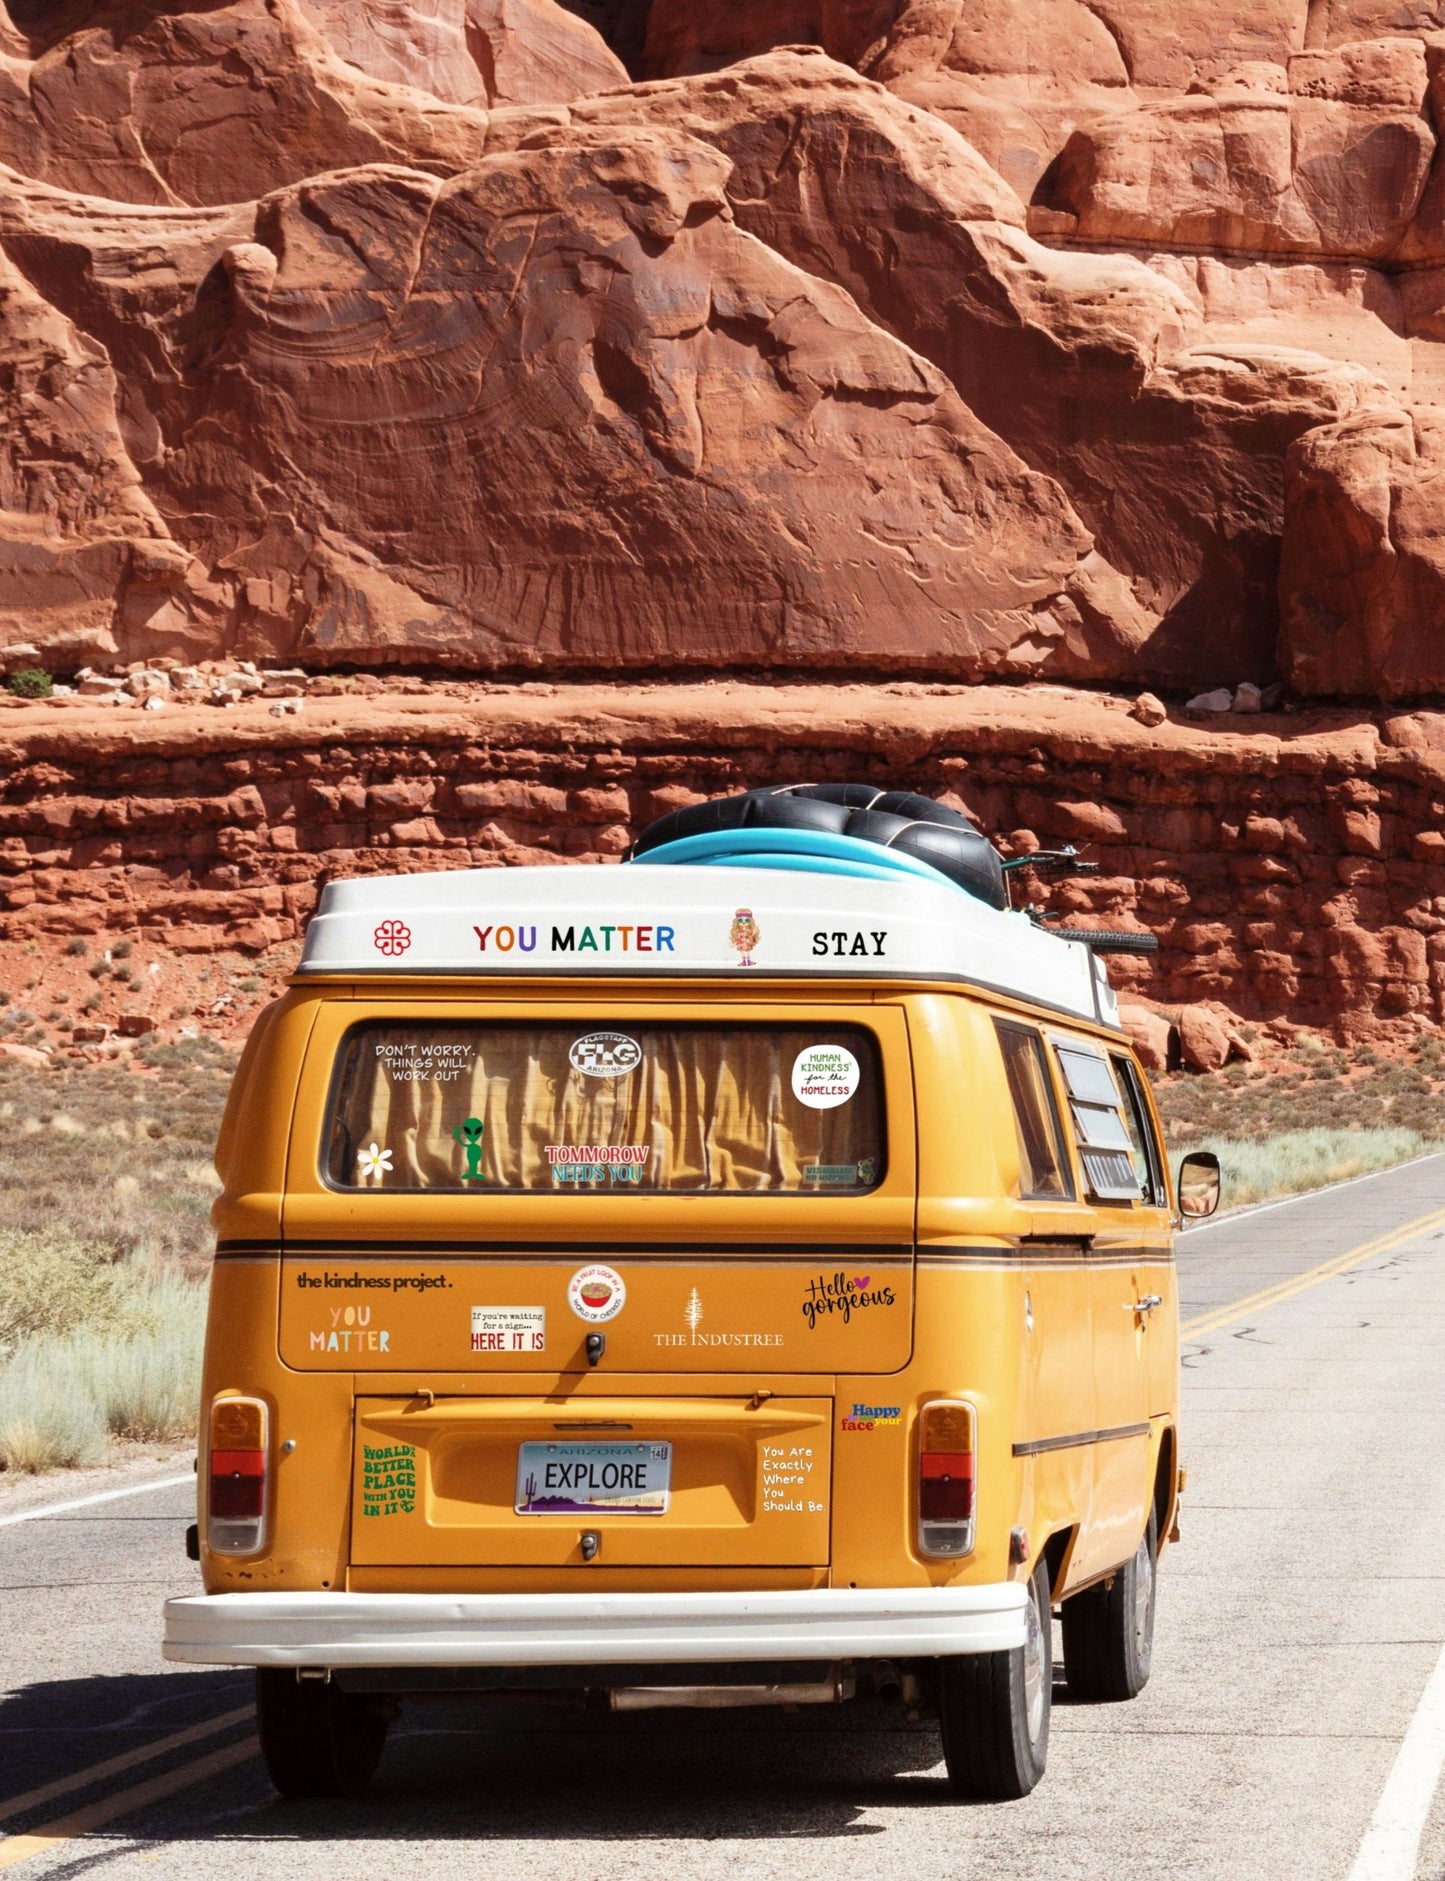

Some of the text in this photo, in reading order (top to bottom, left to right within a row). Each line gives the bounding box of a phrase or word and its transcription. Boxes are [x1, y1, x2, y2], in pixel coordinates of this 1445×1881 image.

[473, 926, 675, 952] YOU MATTER
[812, 931, 888, 956] STAY
[584, 1034, 628, 1044] FLAGSTAFF
[375, 1045, 476, 1056] DON'T WORRY.
[578, 1044, 636, 1066] FLG
[809, 1053, 841, 1062] HUMAN
[384, 1058, 466, 1068] THINGS WILL
[587, 1065, 622, 1073] ARIZONA
[801, 1063, 850, 1072] KINDNESS
[392, 1071, 459, 1080] WORK OUT
[804, 1073, 847, 1085] for the
[801, 1086, 850, 1095] HOMELESS
[544, 1146, 649, 1164] TOMMOROW
[552, 1165, 643, 1182] NEEDS YOU
[297, 1272, 322, 1288] the
[324, 1272, 391, 1288] kindness
[805, 1272, 857, 1302] Hello
[802, 1287, 897, 1330] gorgeous
[329, 1306, 371, 1327] YOU
[472, 1312, 543, 1321] If you're waiting
[309, 1331, 391, 1352] MATTER
[471, 1333, 544, 1350] HERE IT IS
[653, 1333, 785, 1346] THE INDUSTREE
[852, 1403, 901, 1419] Happy
[841, 1418, 874, 1431] face
[873, 1417, 902, 1427] your
[363, 1445, 411, 1460] WORLD
[762, 1445, 813, 1458] You Are
[363, 1458, 415, 1474] BETTER
[762, 1458, 814, 1473] Exactly
[363, 1472, 416, 1490] PLACE
[544, 1462, 647, 1489] EXPLORE
[763, 1473, 805, 1486] Where
[363, 1488, 416, 1502] WITH YOU
[762, 1487, 785, 1499] You
[363, 1502, 399, 1516] IN IT
[762, 1499, 804, 1512] Should
